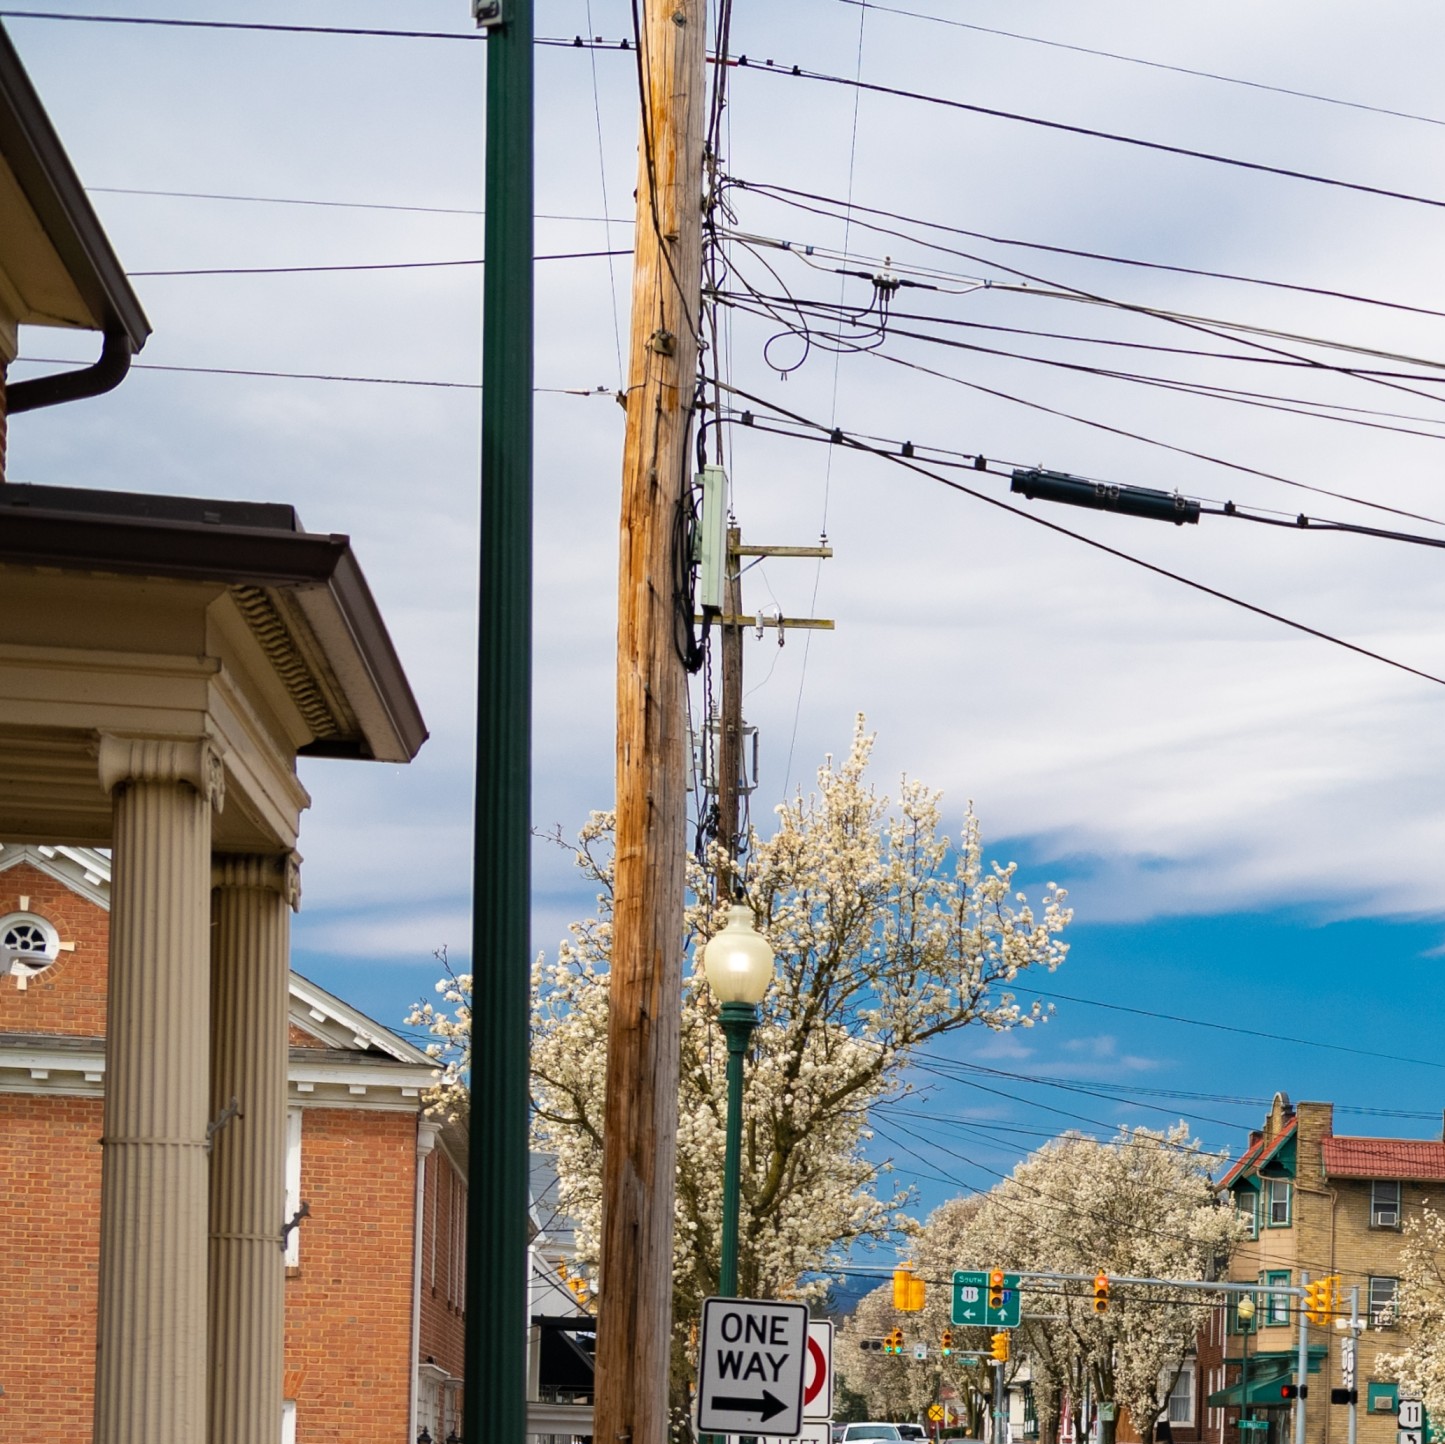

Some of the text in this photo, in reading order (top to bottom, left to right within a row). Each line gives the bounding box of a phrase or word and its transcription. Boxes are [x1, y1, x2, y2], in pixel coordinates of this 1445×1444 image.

[966, 1290, 975, 1300] 11
[721, 1312, 789, 1346] ONE
[717, 1349, 790, 1382] WAY
[1406, 1406, 1419, 1422] 11
